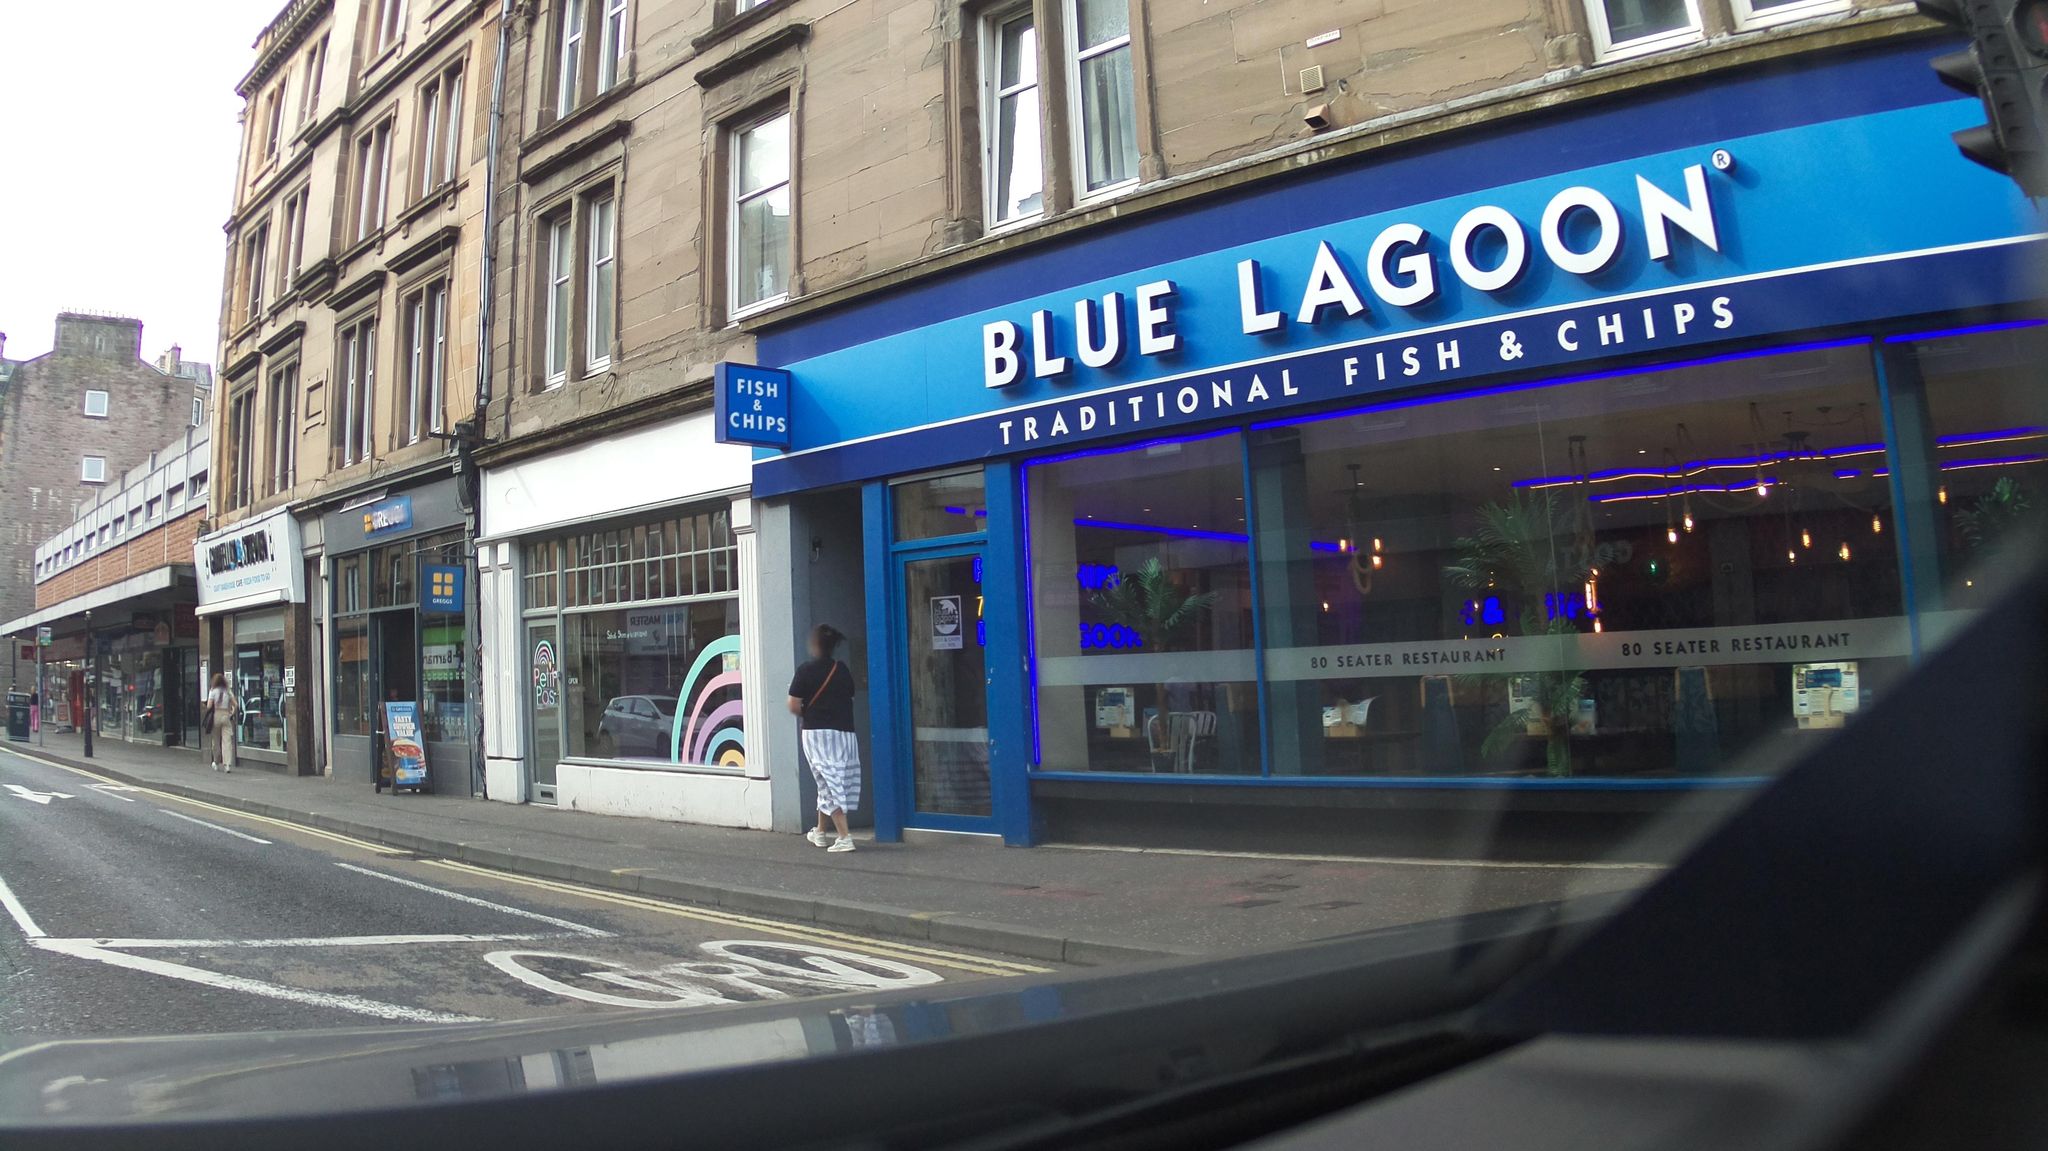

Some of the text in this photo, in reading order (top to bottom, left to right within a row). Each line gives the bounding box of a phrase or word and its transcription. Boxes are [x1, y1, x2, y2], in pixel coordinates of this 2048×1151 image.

[983, 164, 1718, 388] BLUE LAGOON
[1000, 297, 1735, 445] TRADITIONAL FISH & CHIPS
[737, 378, 778, 398] FISH
[753, 399, 763, 411] &
[729, 412, 786, 433] CHIPS
[1622, 632, 1850, 656] 80 SEATER RESTAURANT
[1311, 649, 1505, 669] 80 SEATER RESTAURANT
